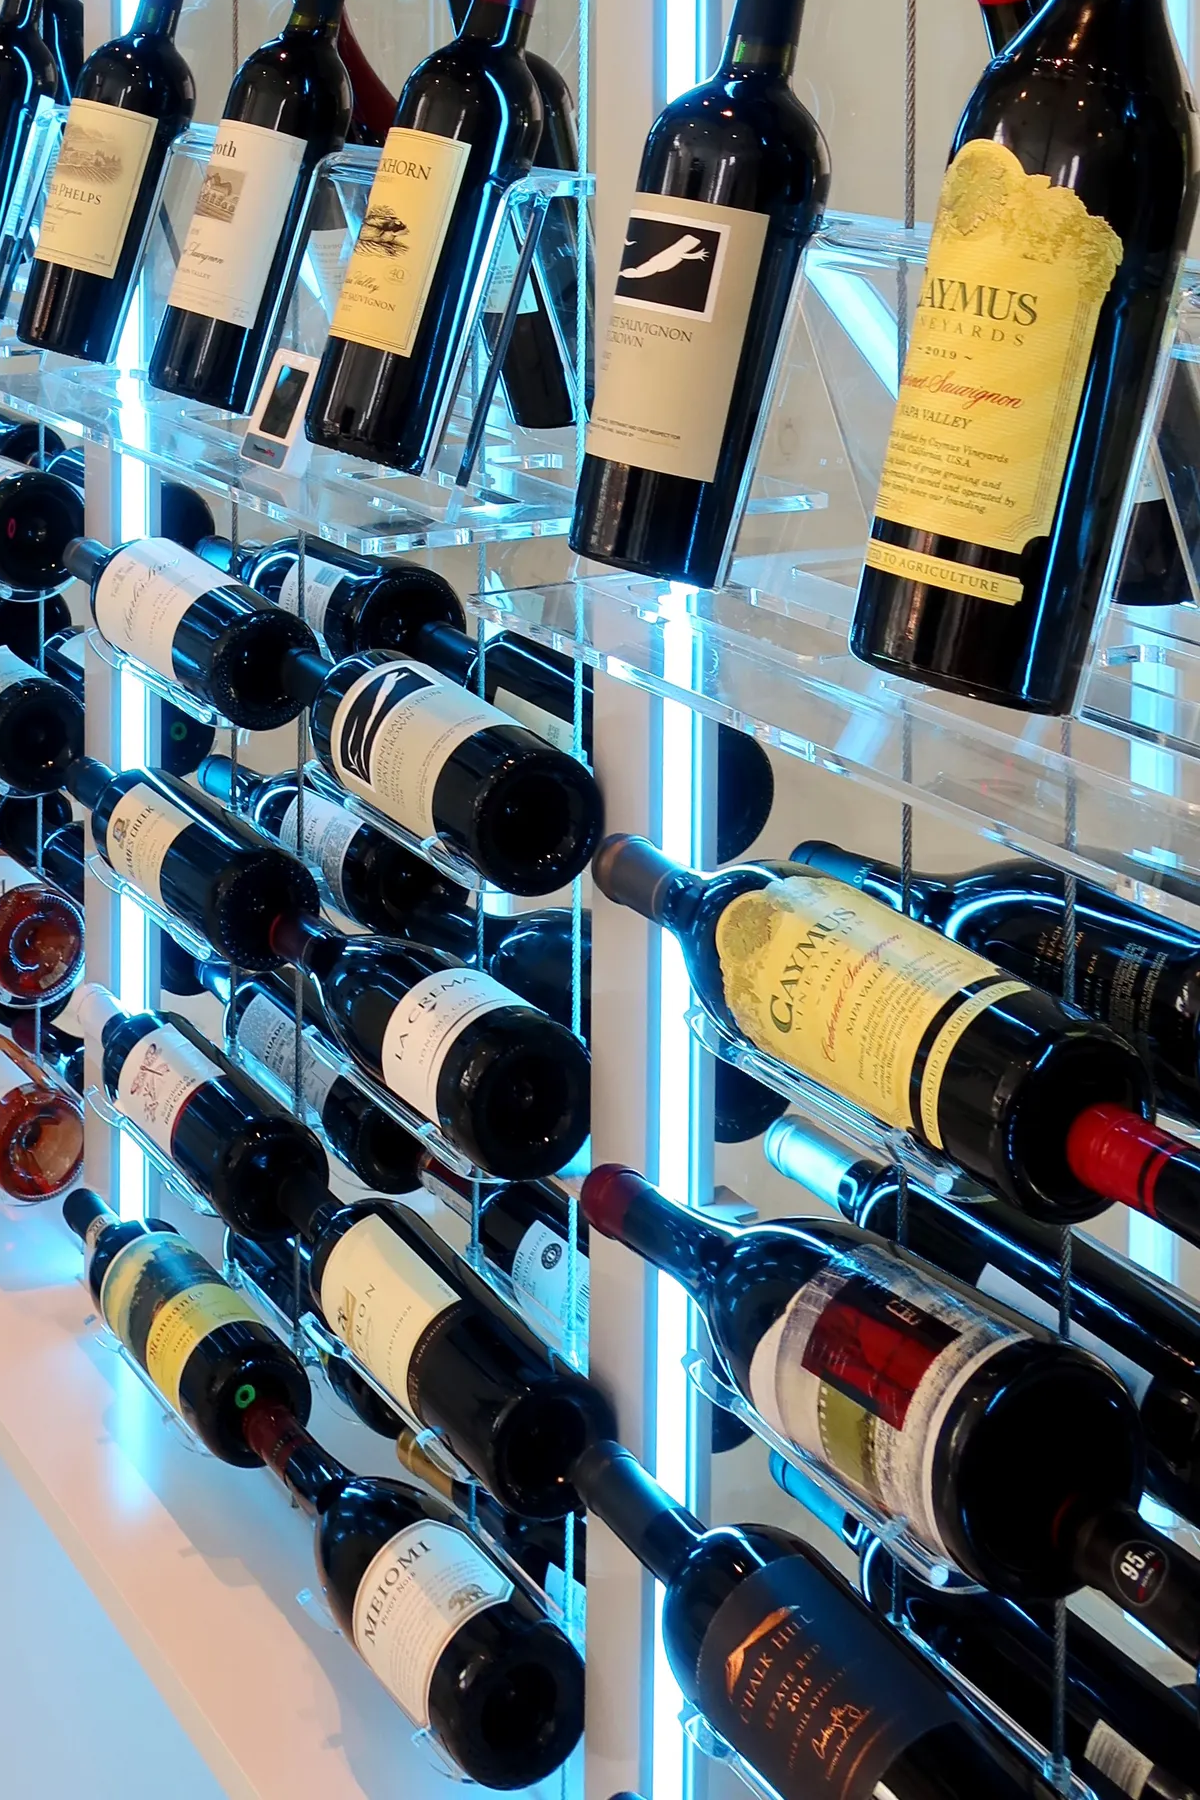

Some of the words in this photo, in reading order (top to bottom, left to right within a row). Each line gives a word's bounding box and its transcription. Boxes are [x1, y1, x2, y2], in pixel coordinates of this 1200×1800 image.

[60, 183, 103, 206] PHELPS
[917, 267, 1038, 326] AYMUS
[619, 318, 693, 343] SAUVIGNON
[925, 346, 957, 361] 2019
[928, 370, 1023, 410] Sauvignon
[922, 409, 973, 430] VALLEY
[963, 445, 1009, 464] Vineyards
[962, 488, 1002, 504] operated
[1005, 496, 1016, 508] by
[982, 480, 1002, 490] and
[883, 552, 898, 566] TO
[899, 556, 1000, 594] AGRICULTURE
[390, 690, 442, 735] SAUVIGNON
[130, 806, 155, 838] CREEK
[770, 907, 857, 1034] CAYMUS
[794, 918, 864, 1031] VINEYARDS
[394, 1033, 409, 1061] LA
[408, 975, 477, 1024] CREMA
[820, 991, 846, 1064] Cabernet
[844, 933, 904, 991] Sauvignon
[846, 1001, 861, 1036] NAPA
[860, 958, 892, 1001] VALLEY
[263, 1021, 286, 1063] ALUADO
[921, 1055, 942, 1136] DEDICATED
[947, 983, 1014, 1039] AGRICULTURE
[1119, 1549, 1149, 1583] 95
[363, 1539, 433, 1645] MEIOMI
